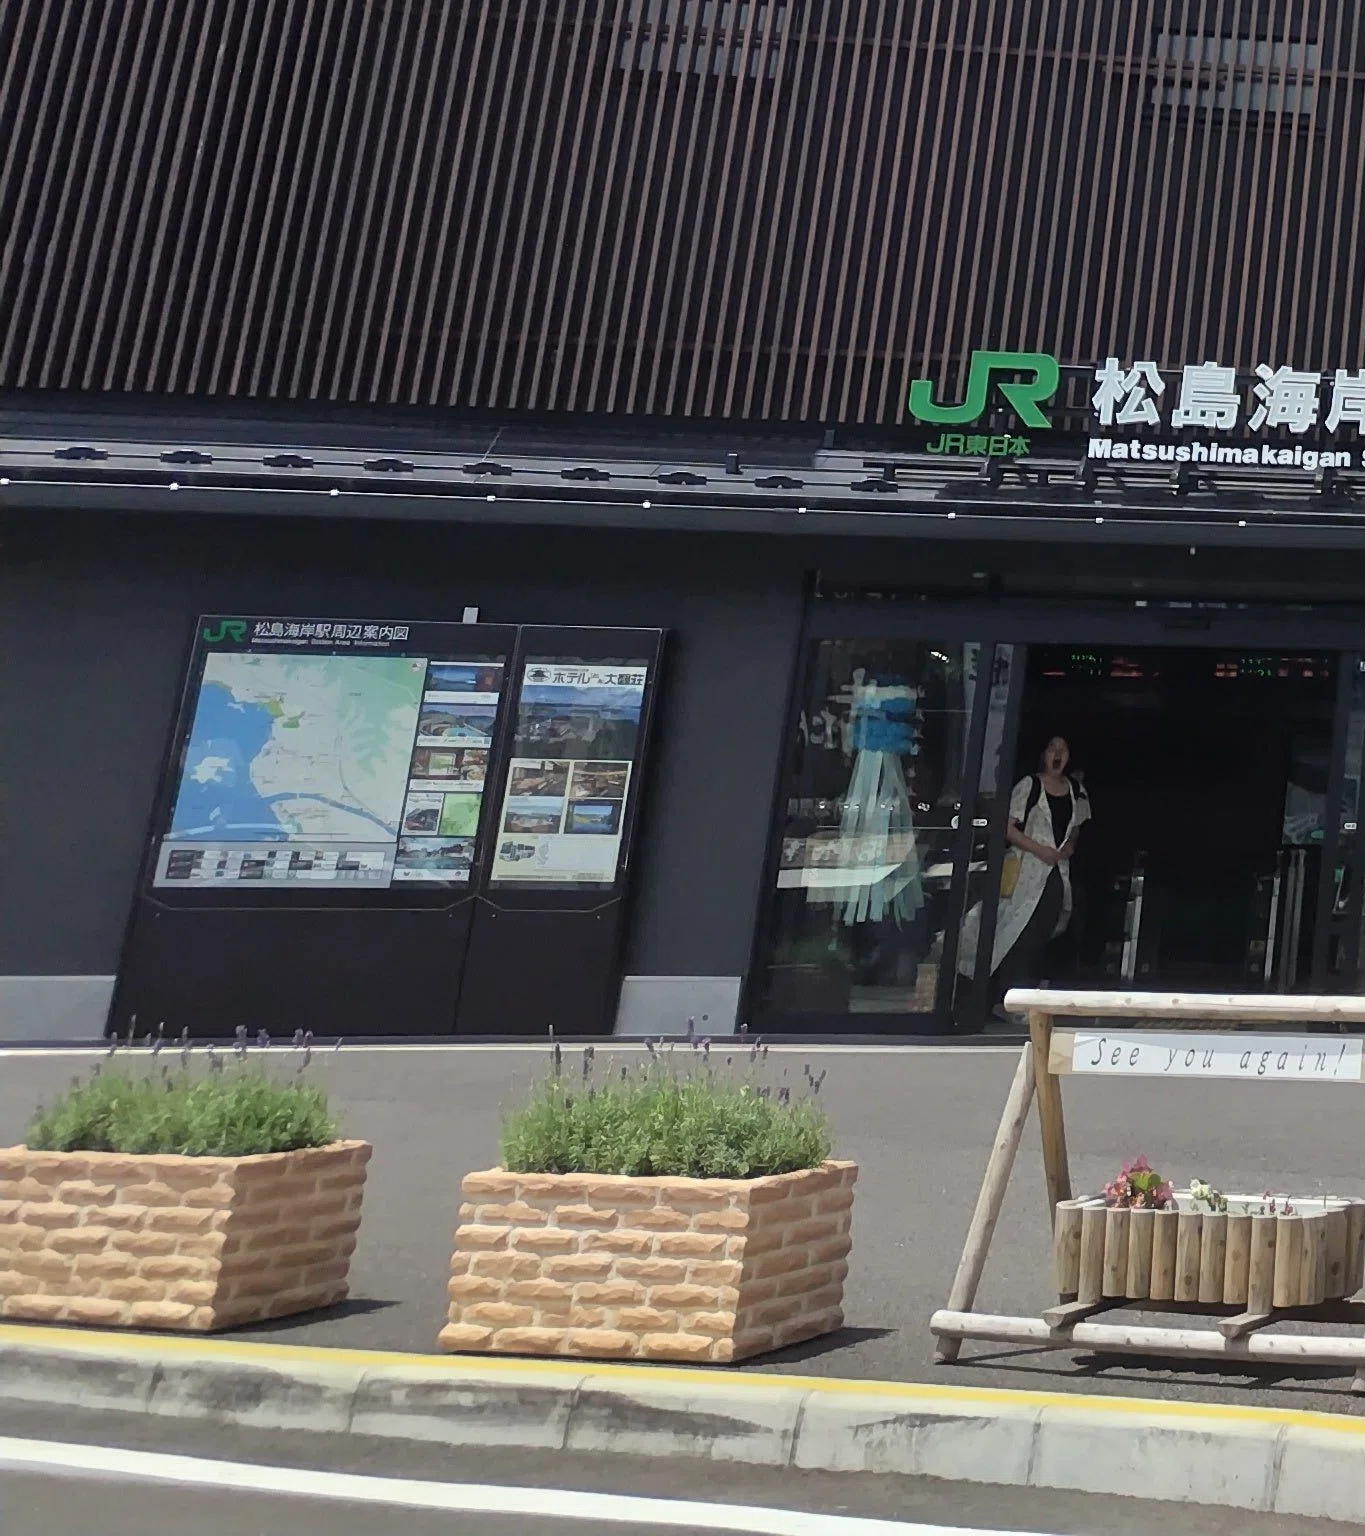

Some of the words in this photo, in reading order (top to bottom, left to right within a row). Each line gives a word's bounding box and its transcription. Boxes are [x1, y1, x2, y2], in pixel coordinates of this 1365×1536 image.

[908, 350, 1059, 429] JR
[926, 434, 1030, 458] JR東日本
[1088, 438, 1351, 470] Matsushimakaigan
[203, 620, 247, 643] JR
[253, 621, 410, 641] 松島海岸駅周辺案内図
[1091, 1037, 1140, 1066] See
[1164, 1048, 1215, 1072] you
[1239, 1042, 1346, 1076] again!
